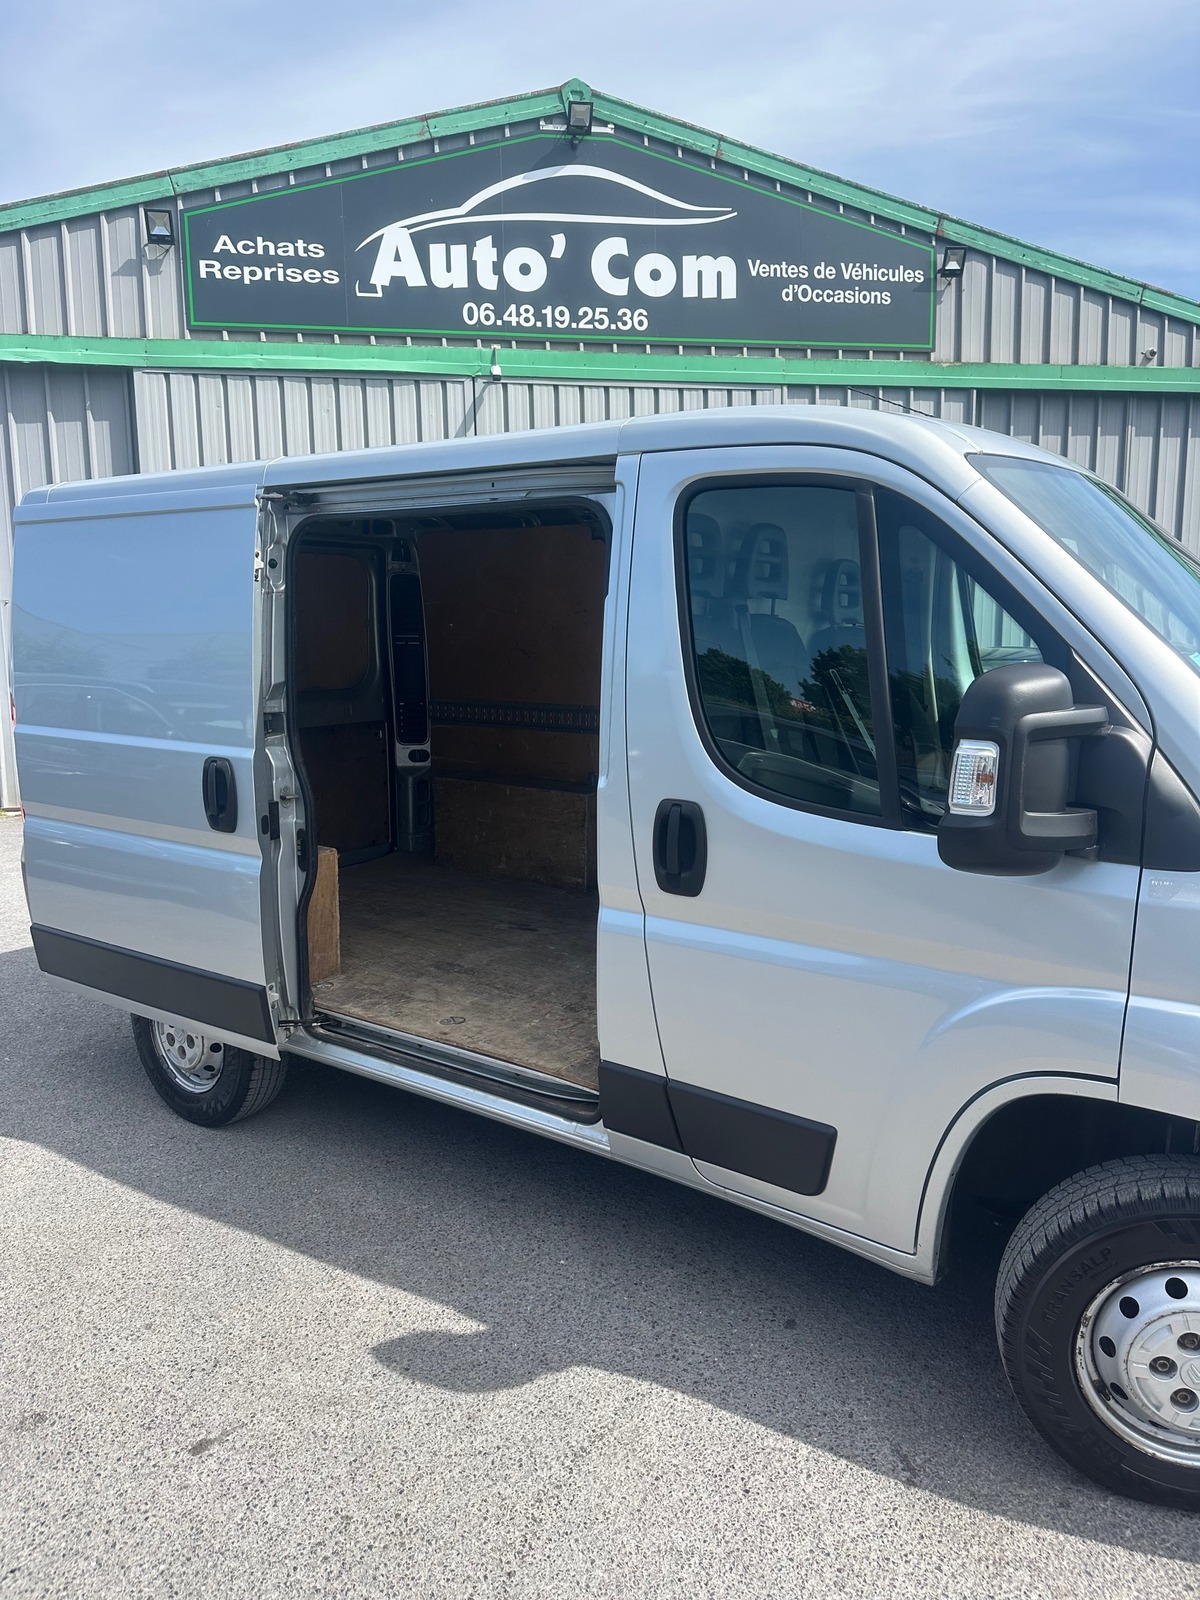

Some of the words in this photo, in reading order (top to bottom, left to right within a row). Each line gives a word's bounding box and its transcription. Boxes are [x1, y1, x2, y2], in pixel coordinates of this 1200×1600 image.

[212, 234, 325, 258] Achats
[198, 259, 340, 285] Reprises
[590, 236, 737, 299] Com
[747, 259, 809, 279] Ventes
[813, 262, 837, 280] de
[840, 263, 925, 283] Véhicules
[781, 284, 891, 305] d'Occasions
[462, 302, 649, 331] 06.48.19.25.36
[1045, 1246, 1112, 1320] TRANSALP
